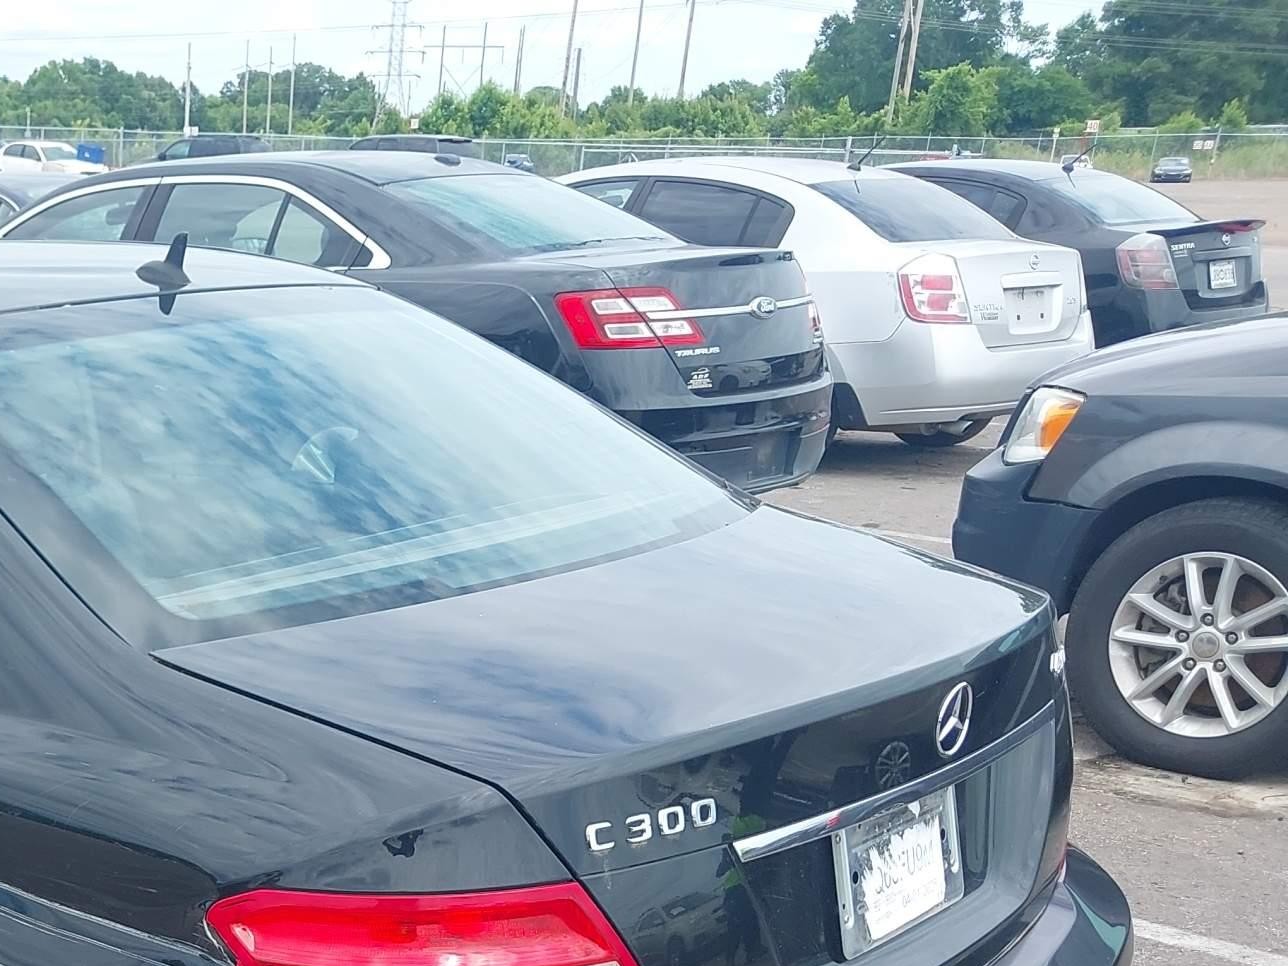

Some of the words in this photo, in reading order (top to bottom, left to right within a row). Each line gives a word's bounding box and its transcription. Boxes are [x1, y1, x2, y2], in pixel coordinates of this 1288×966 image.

[1171, 242, 1195, 251] SENTRA
[675, 346, 720, 357] TAURUS
[585, 821, 615, 852] C
[625, 798, 717, 843] 300
